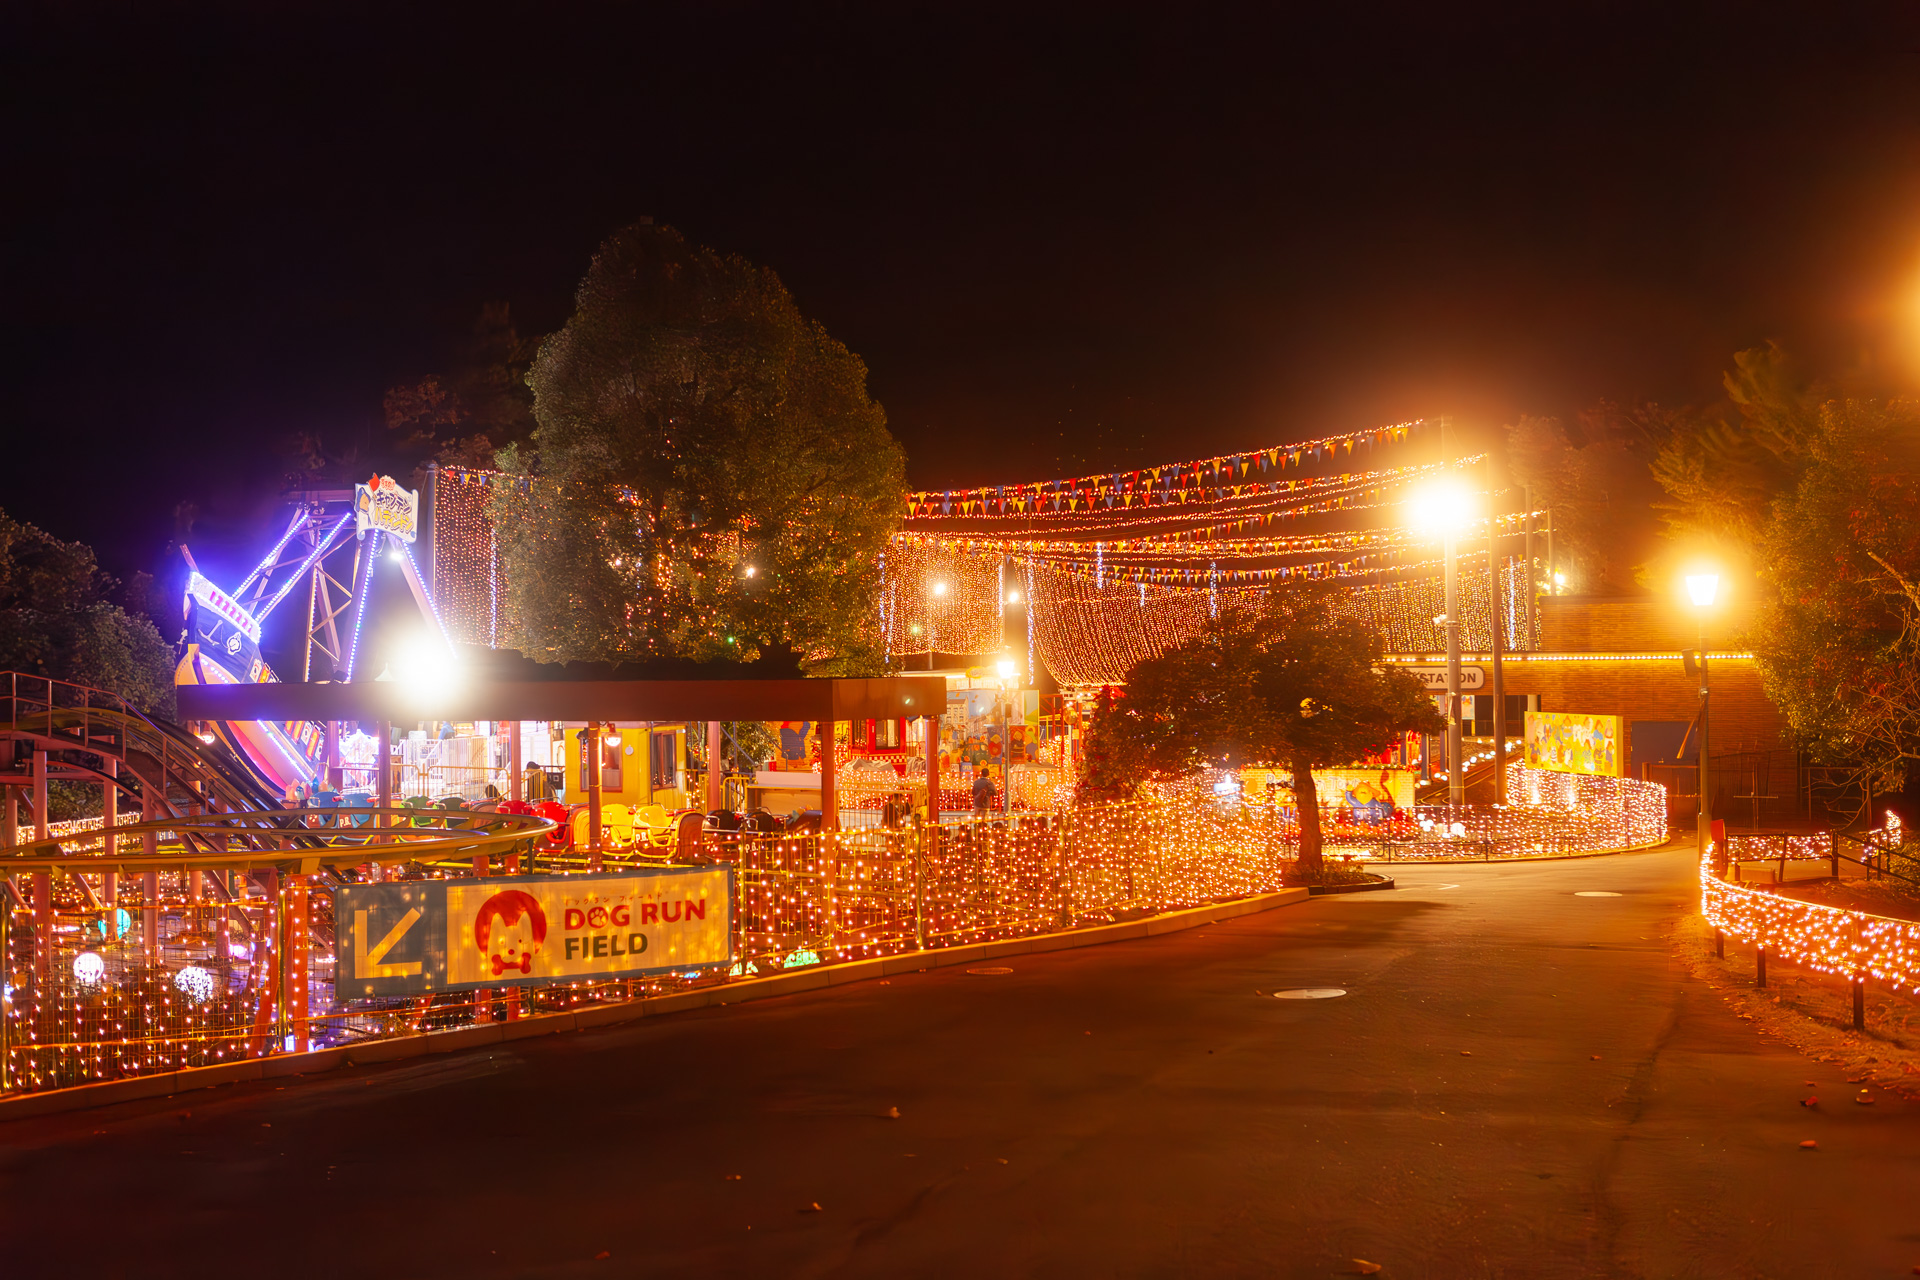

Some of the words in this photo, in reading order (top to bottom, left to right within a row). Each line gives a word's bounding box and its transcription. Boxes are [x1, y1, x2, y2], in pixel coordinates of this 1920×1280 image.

[1419, 673, 1476, 683] STAON
[564, 905, 630, 931] DOG
[641, 899, 706, 925] RUN
[564, 933, 648, 960] FIELD
